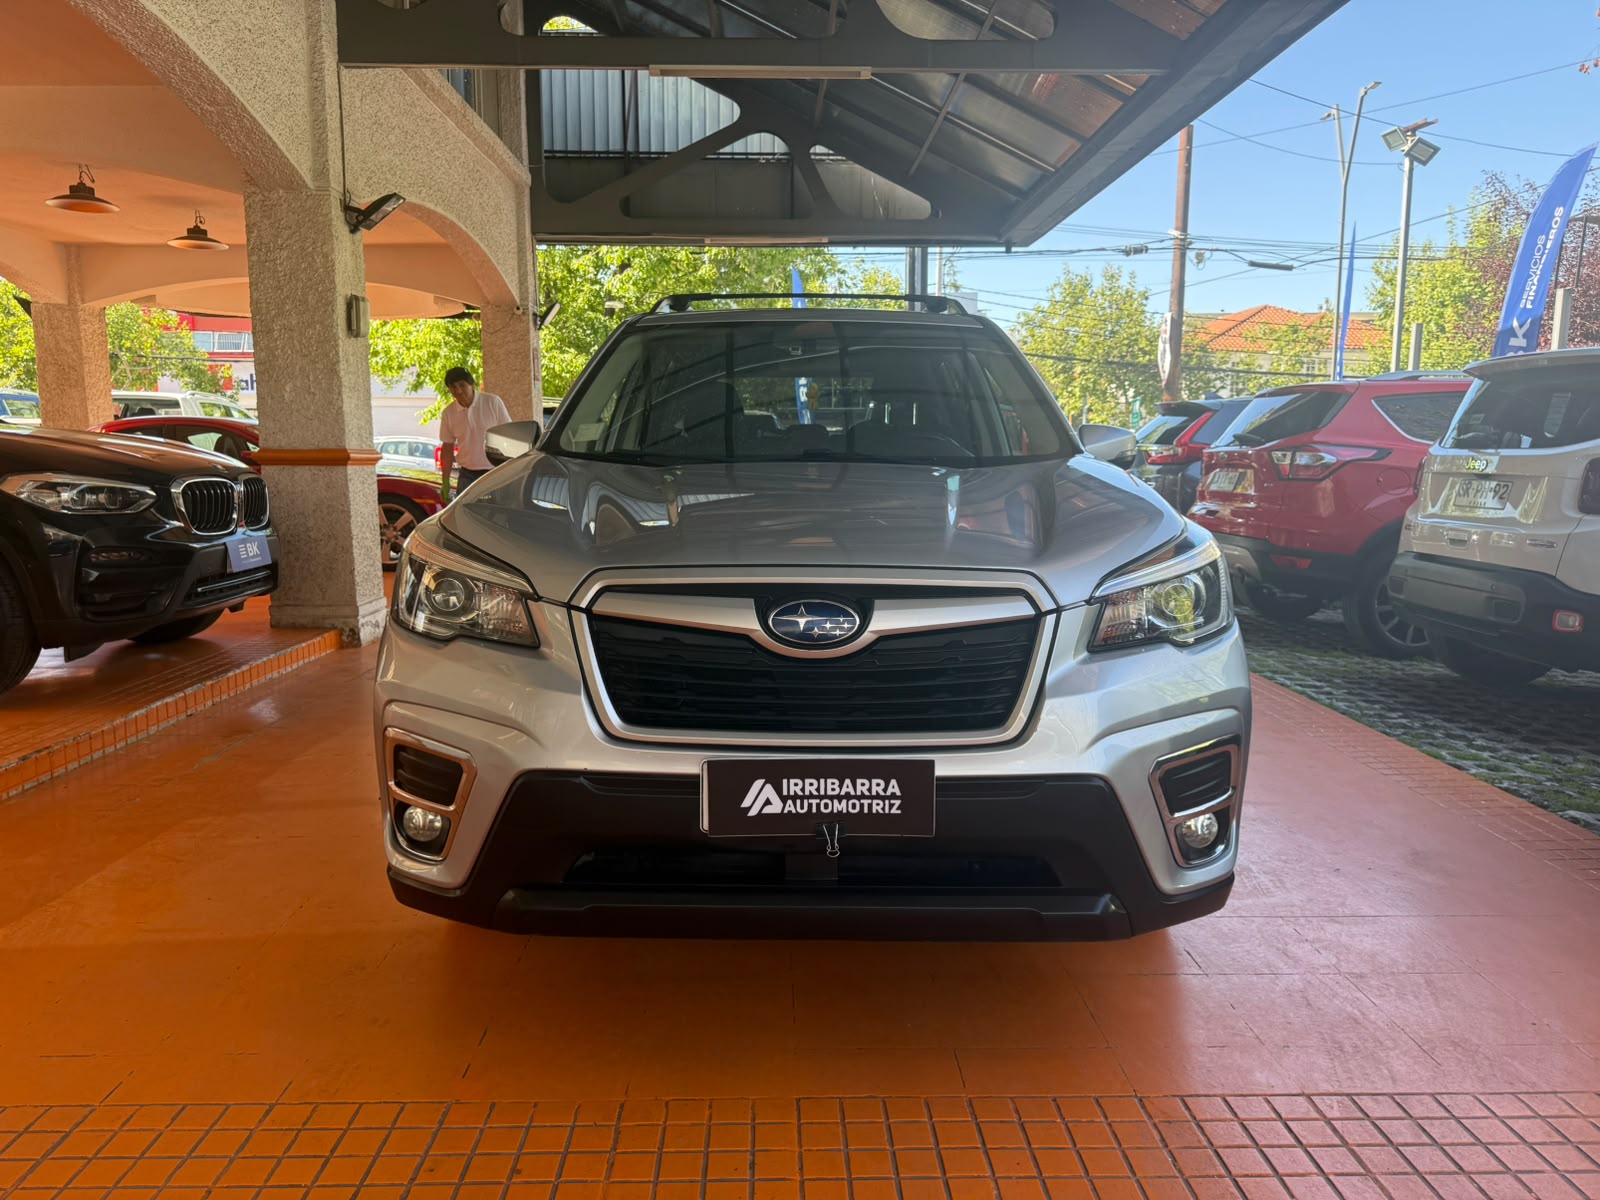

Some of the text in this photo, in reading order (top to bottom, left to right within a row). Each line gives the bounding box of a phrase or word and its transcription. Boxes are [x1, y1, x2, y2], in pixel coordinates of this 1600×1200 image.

[1526, 206, 1564, 309] FINANEROS
[1519, 234, 1546, 308] SERVICIOS
[1465, 457, 1488, 471] Jeep
[782, 778, 902, 796] IRRIBARRA
[783, 799, 902, 814] AUTOMOTRIZ
